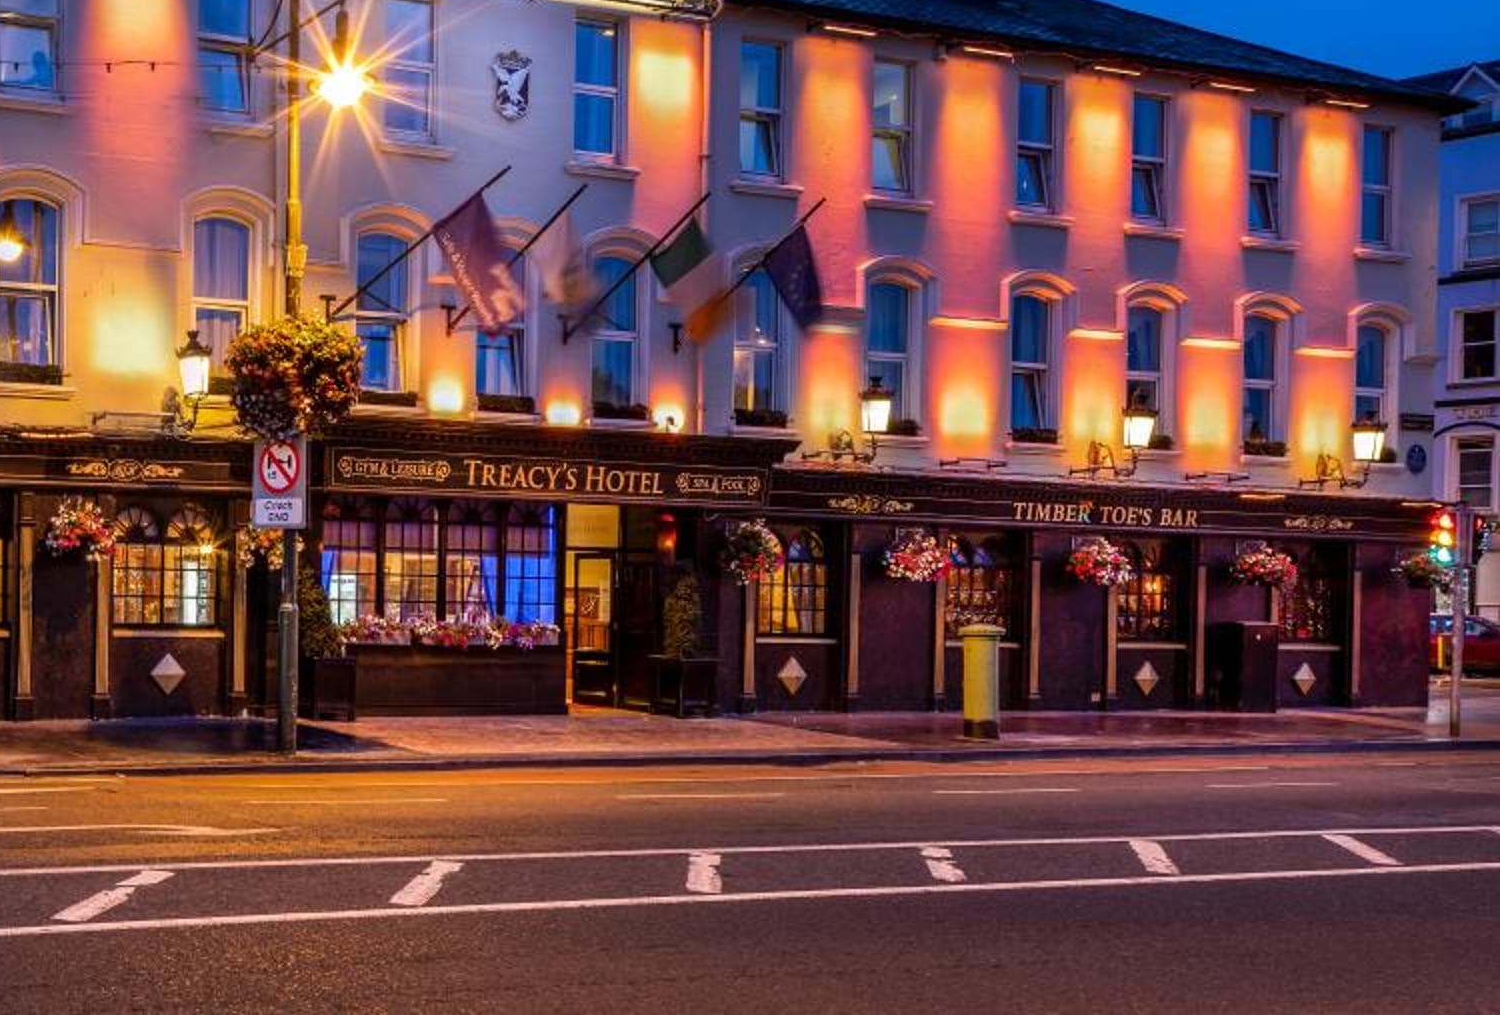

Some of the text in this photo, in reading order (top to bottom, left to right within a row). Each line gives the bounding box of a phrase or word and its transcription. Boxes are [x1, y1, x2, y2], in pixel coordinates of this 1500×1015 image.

[463, 458, 664, 495] TREACY'S HOTEL
[1013, 501, 1199, 528] TIMBER TOE'S BAR
